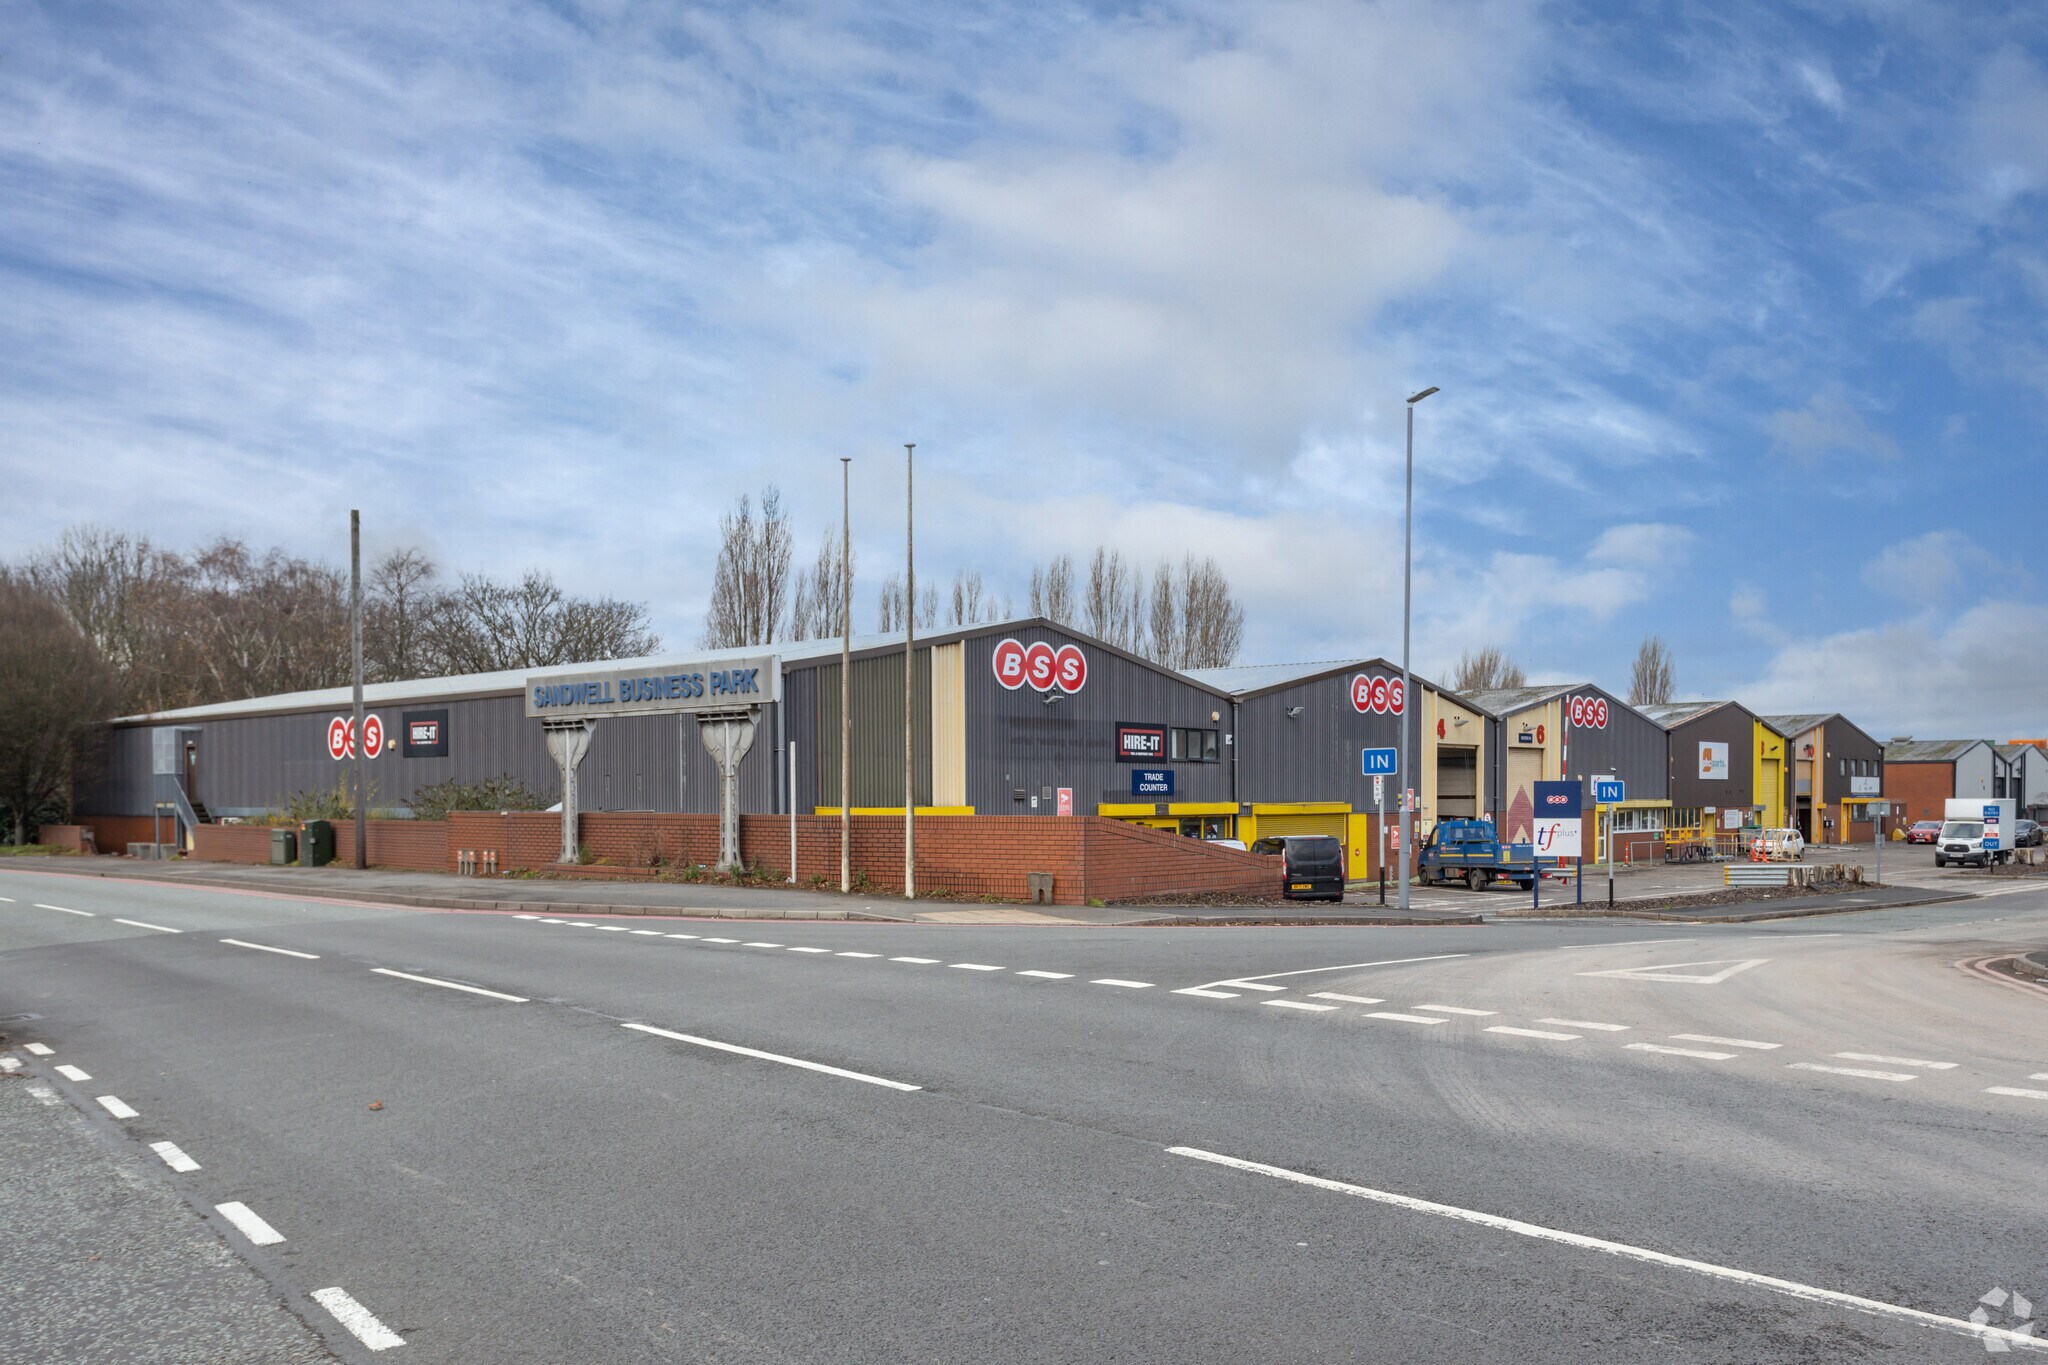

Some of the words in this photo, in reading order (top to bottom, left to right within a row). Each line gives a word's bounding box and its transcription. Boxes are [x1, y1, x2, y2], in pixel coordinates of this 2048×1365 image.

[533, 681, 615, 708] SANDWELL
[619, 672, 704, 702] BUSINESS
[709, 668, 759, 696] PARK
[412, 726, 436, 740] HIRE-IT
[1437, 718, 1446, 740] 4
[1536, 724, 1545, 744] 6
[1123, 734, 1160, 750] HIRE-IT
[1370, 754, 1389, 769] IN
[1143, 773, 1164, 781] TRADE
[1139, 783, 1168, 792] COUNTER
[1602, 786, 1618, 798] IN
